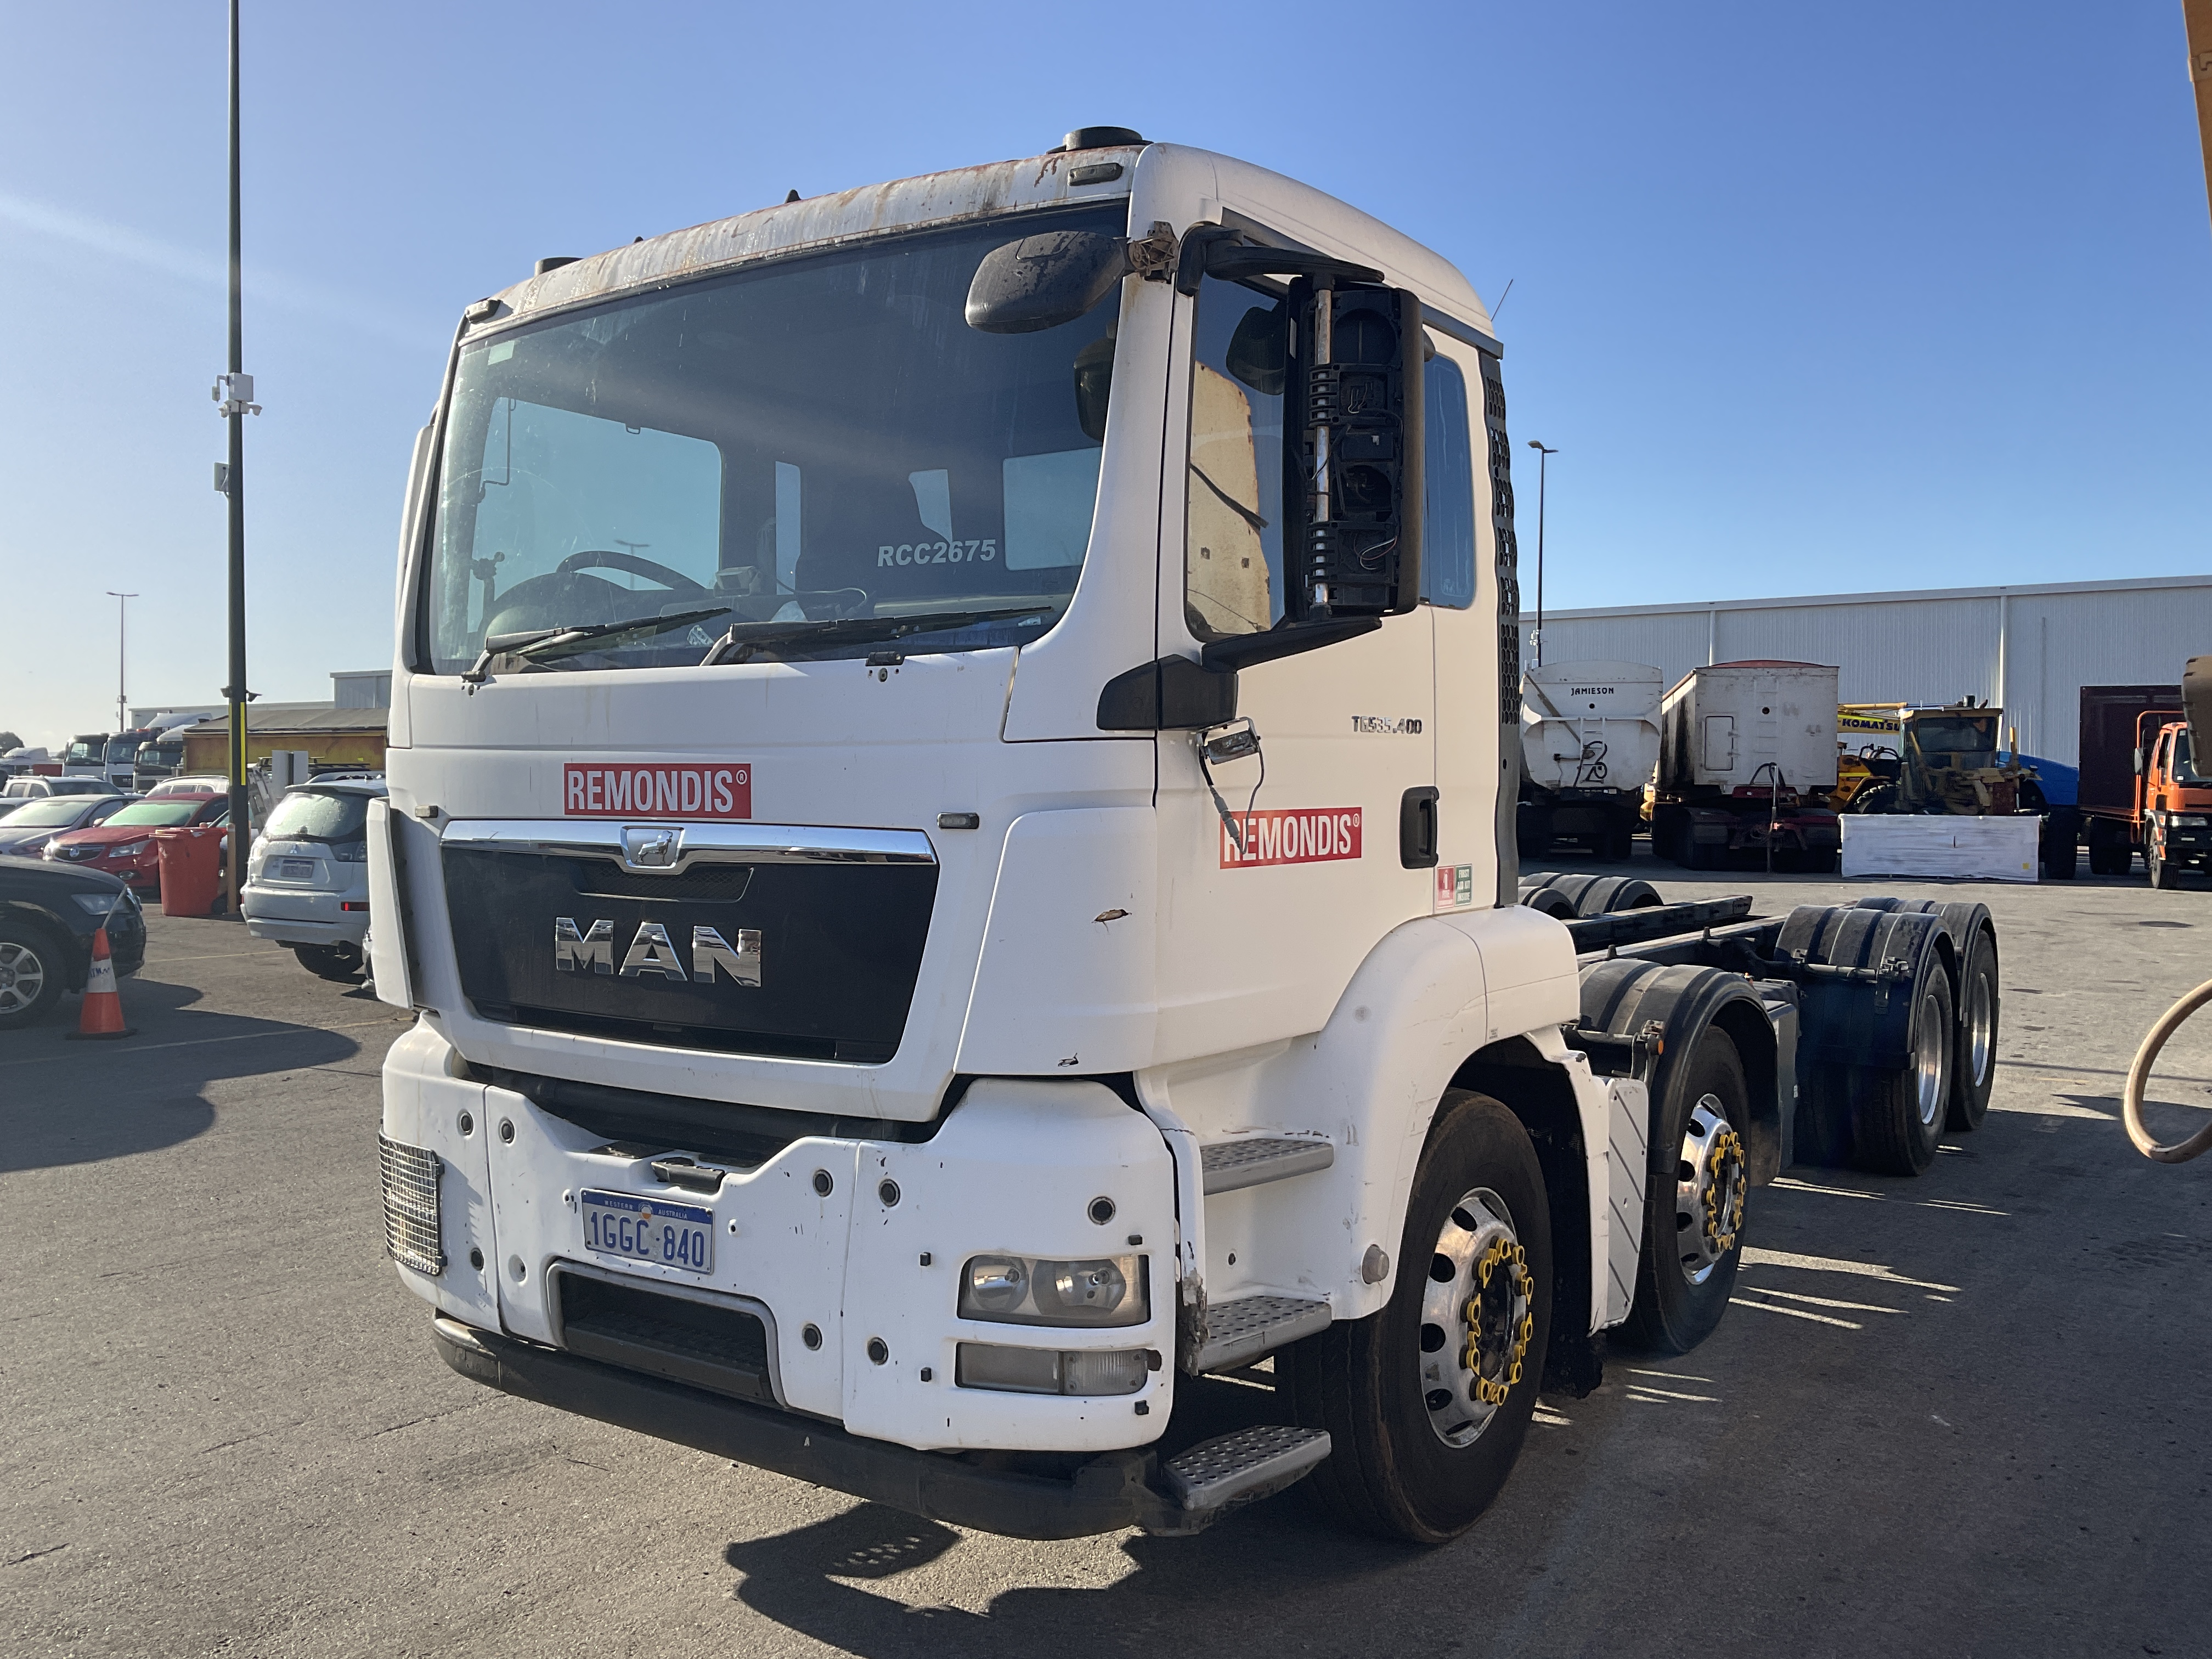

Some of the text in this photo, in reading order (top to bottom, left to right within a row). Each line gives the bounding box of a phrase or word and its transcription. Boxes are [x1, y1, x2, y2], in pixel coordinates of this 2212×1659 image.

[877, 539, 996, 567] RCC2675
[1571, 687, 1614, 696] JAMIESON
[555, 917, 763, 988] MAN
[604, 1200, 688, 1220] WESTERN AUSTRALIA
